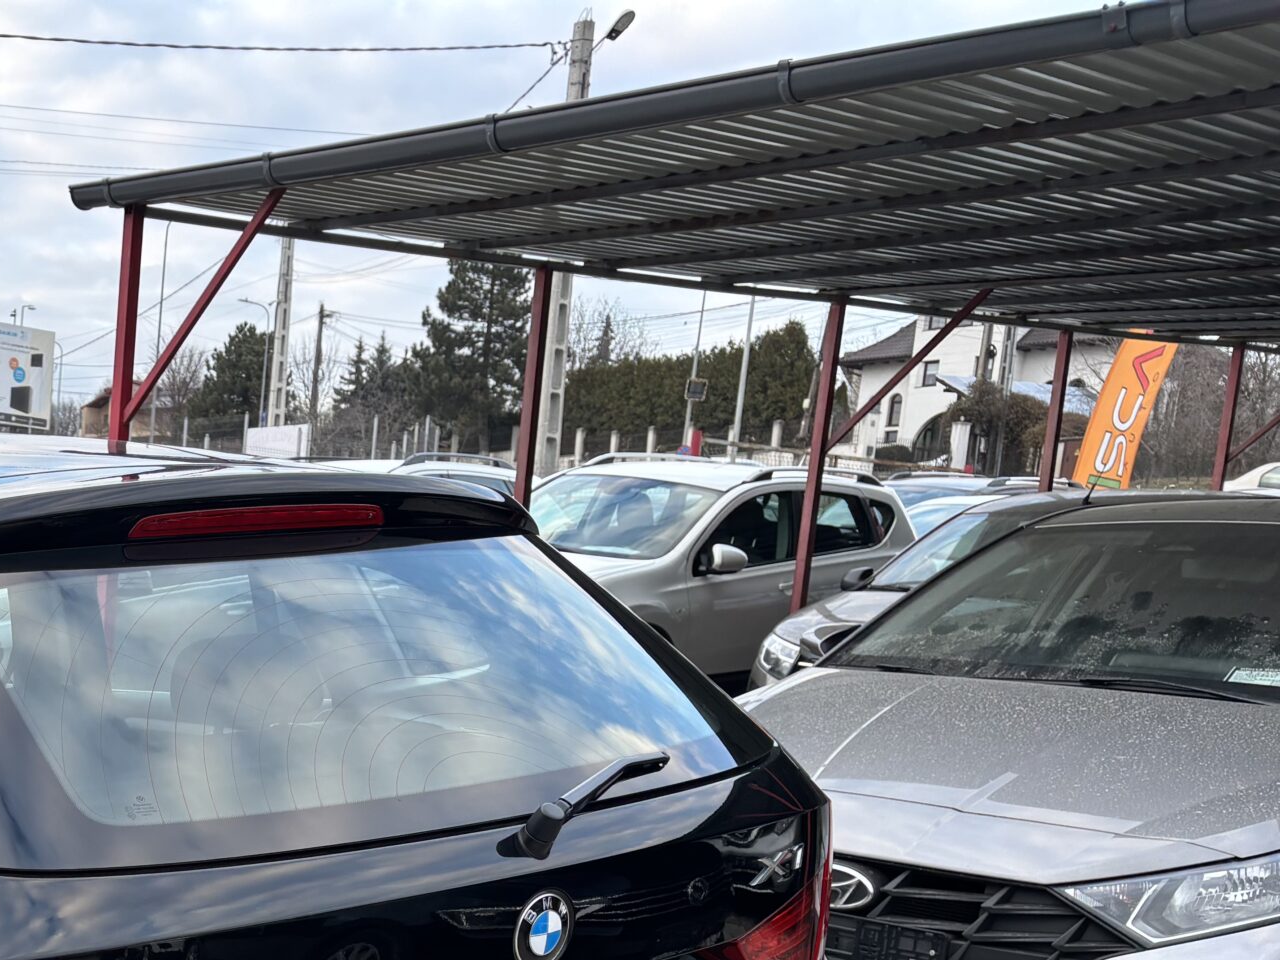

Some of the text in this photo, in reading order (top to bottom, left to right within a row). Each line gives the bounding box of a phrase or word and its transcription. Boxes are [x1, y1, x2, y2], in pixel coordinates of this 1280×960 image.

[1086, 344, 1167, 489] ISCA
[749, 843, 804, 886] X1
[524, 896, 567, 924] BMW
